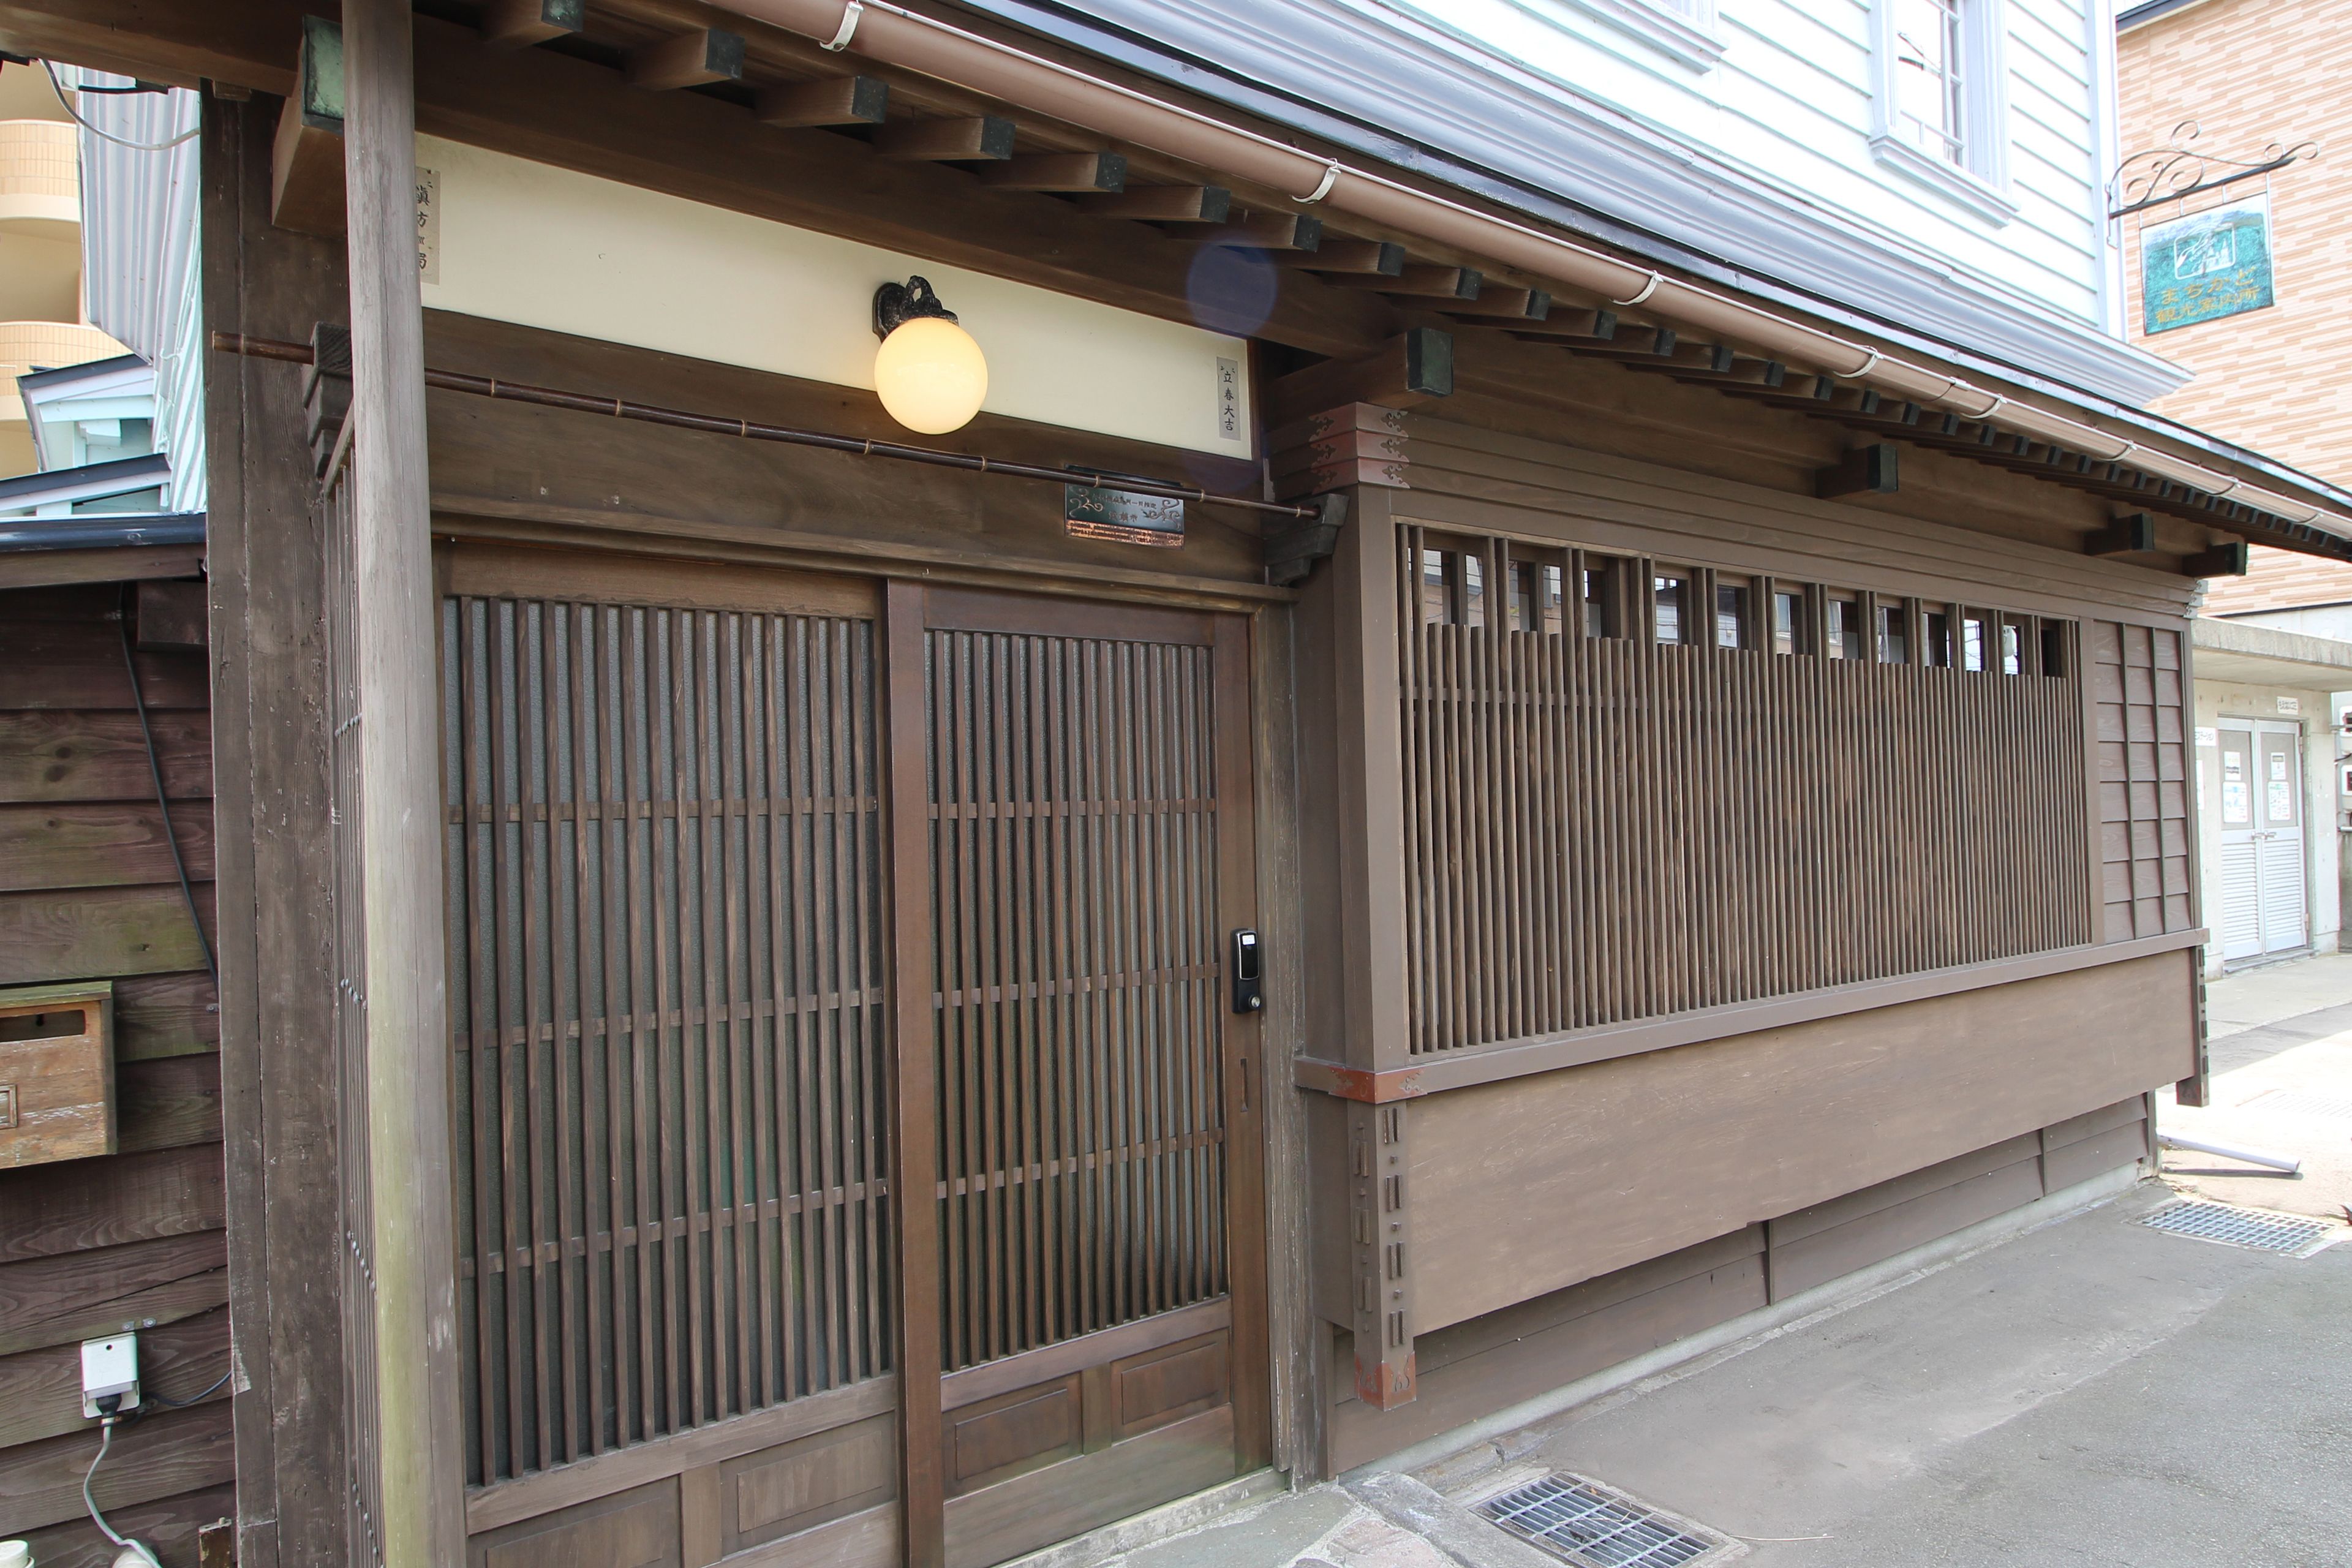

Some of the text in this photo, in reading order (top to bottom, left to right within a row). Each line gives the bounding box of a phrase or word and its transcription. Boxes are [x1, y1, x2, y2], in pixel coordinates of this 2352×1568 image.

[2155, 285, 2260, 323] 観光案内所
[2161, 266, 2256, 305] まちかど
[1223, 371, 1235, 431] 立春大吉
